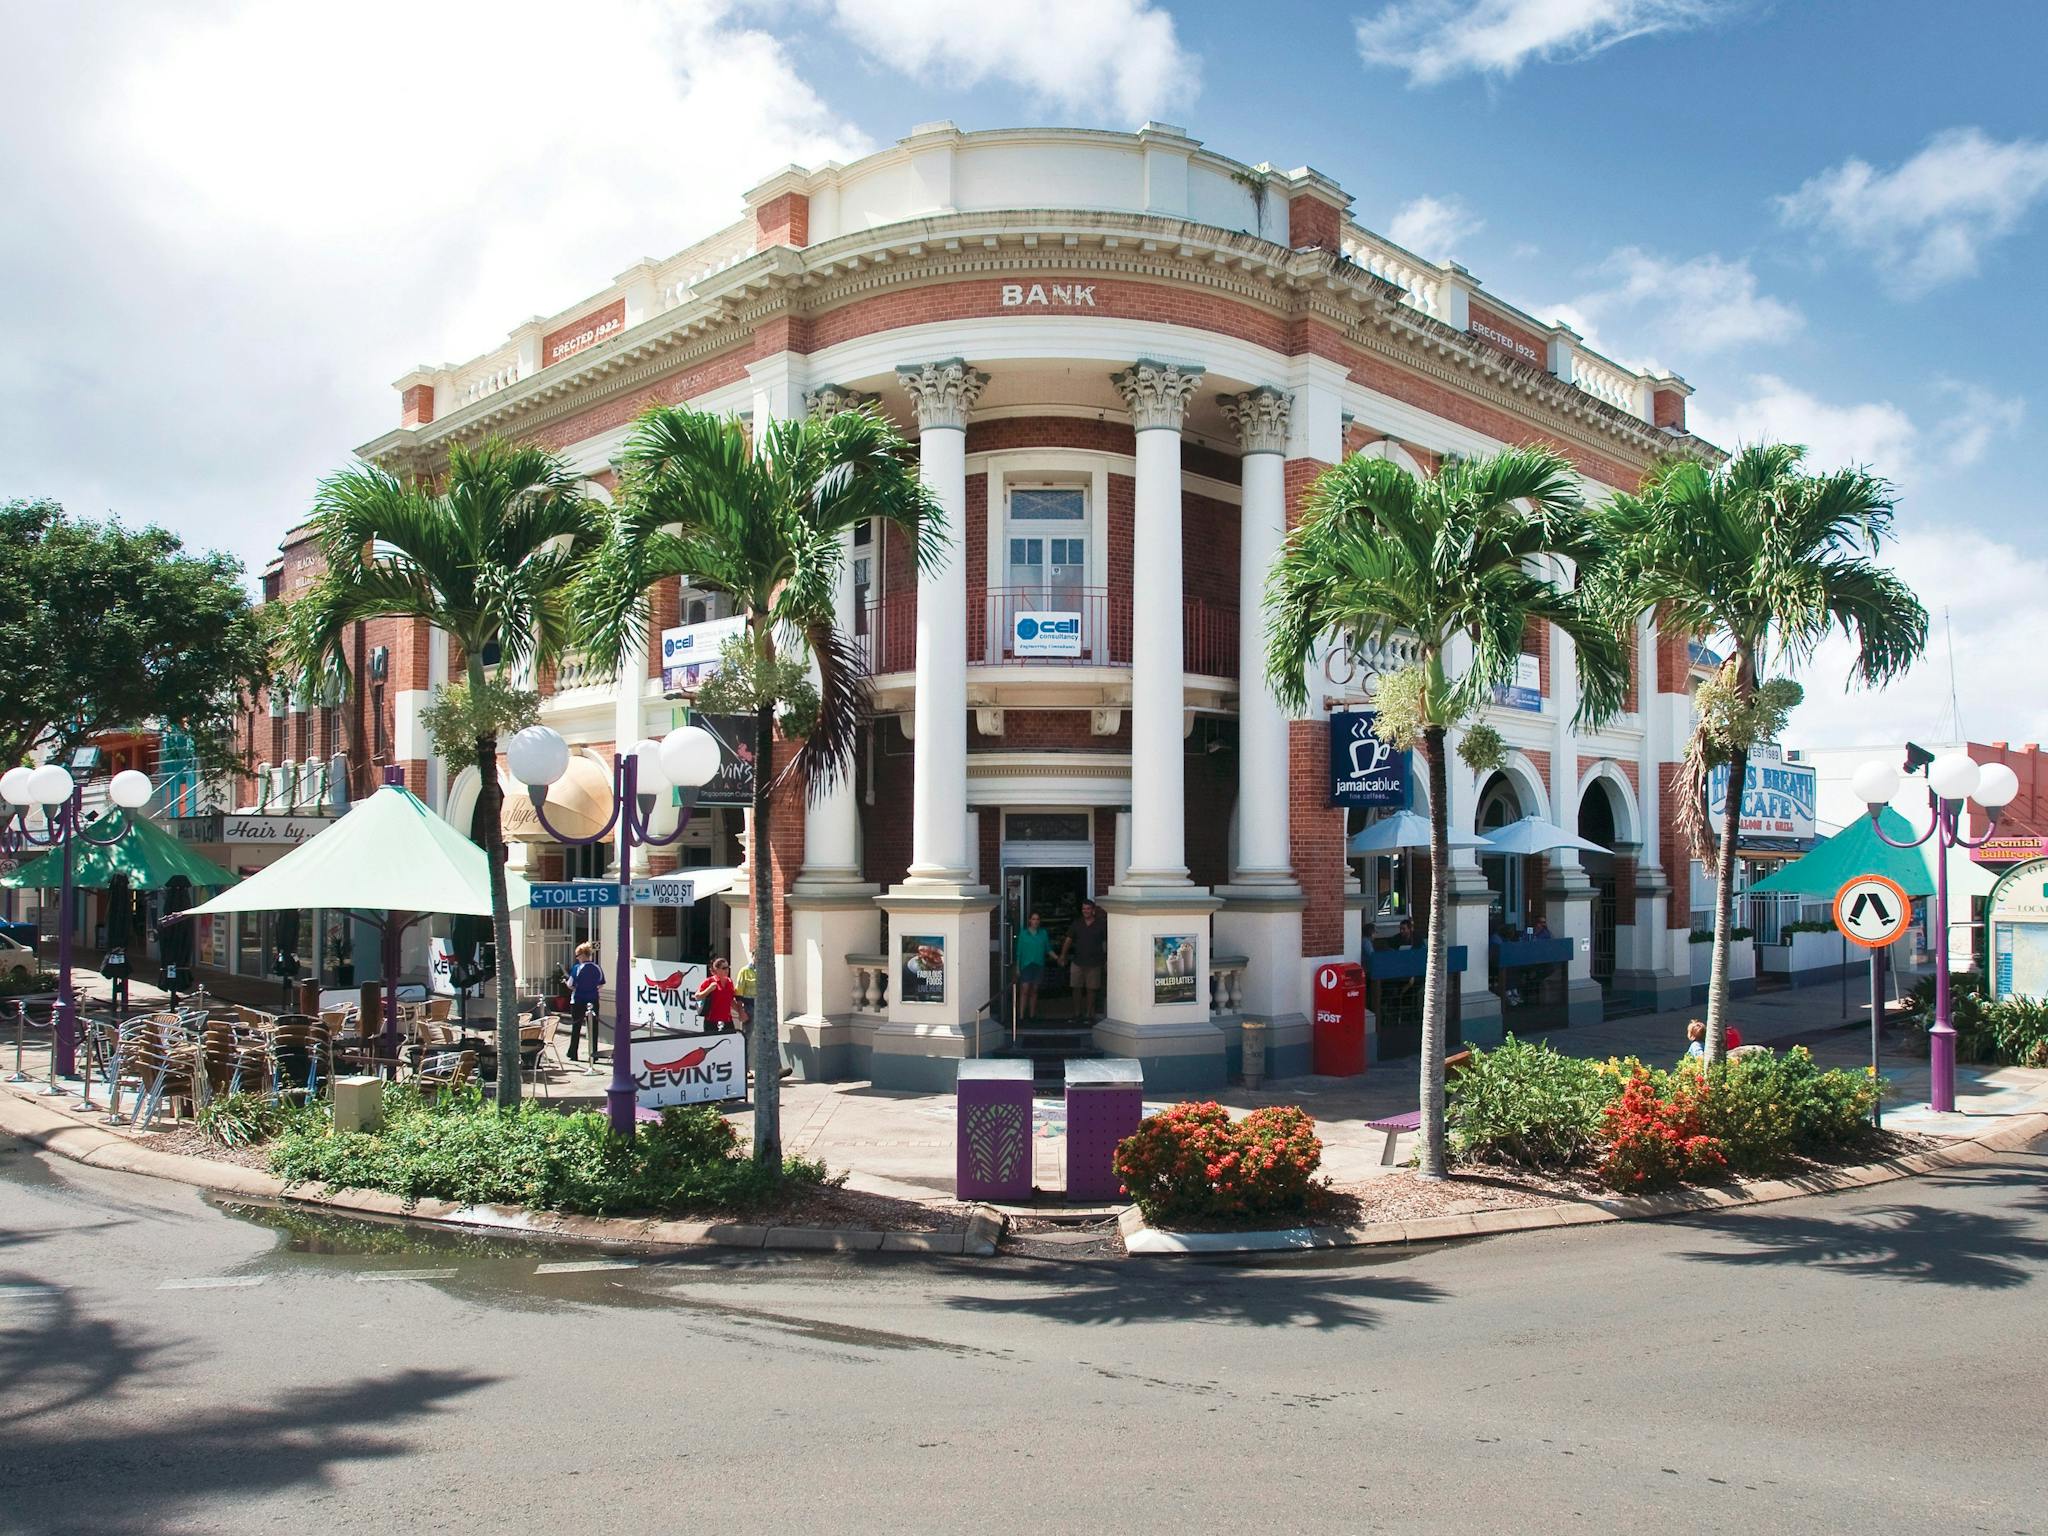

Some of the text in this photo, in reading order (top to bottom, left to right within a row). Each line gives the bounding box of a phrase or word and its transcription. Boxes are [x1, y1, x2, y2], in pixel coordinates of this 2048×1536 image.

[1002, 283, 1096, 306] BANK
[1472, 320, 1513, 349] ERECTED
[552, 330, 594, 358] ERECTED
[1040, 618, 1079, 634] cell
[675, 634, 694, 650] cell
[1039, 633, 1079, 641] consultancy
[1335, 777, 1400, 796] jamaicablue
[1761, 767, 1814, 814] BREATH
[1739, 792, 1792, 819] CAFE
[227, 820, 277, 838] Hair
[1740, 819, 1762, 831] ALOON
[1766, 820, 1772, 831] &
[652, 884, 692, 898] WOOD ST
[1996, 863, 2046, 902] CITY OF
[542, 887, 609, 904] TOILETS
[658, 896, 685, 904] 98-31
[1155, 977, 1176, 987] CHILLED
[1317, 1013, 1342, 1024] POST
